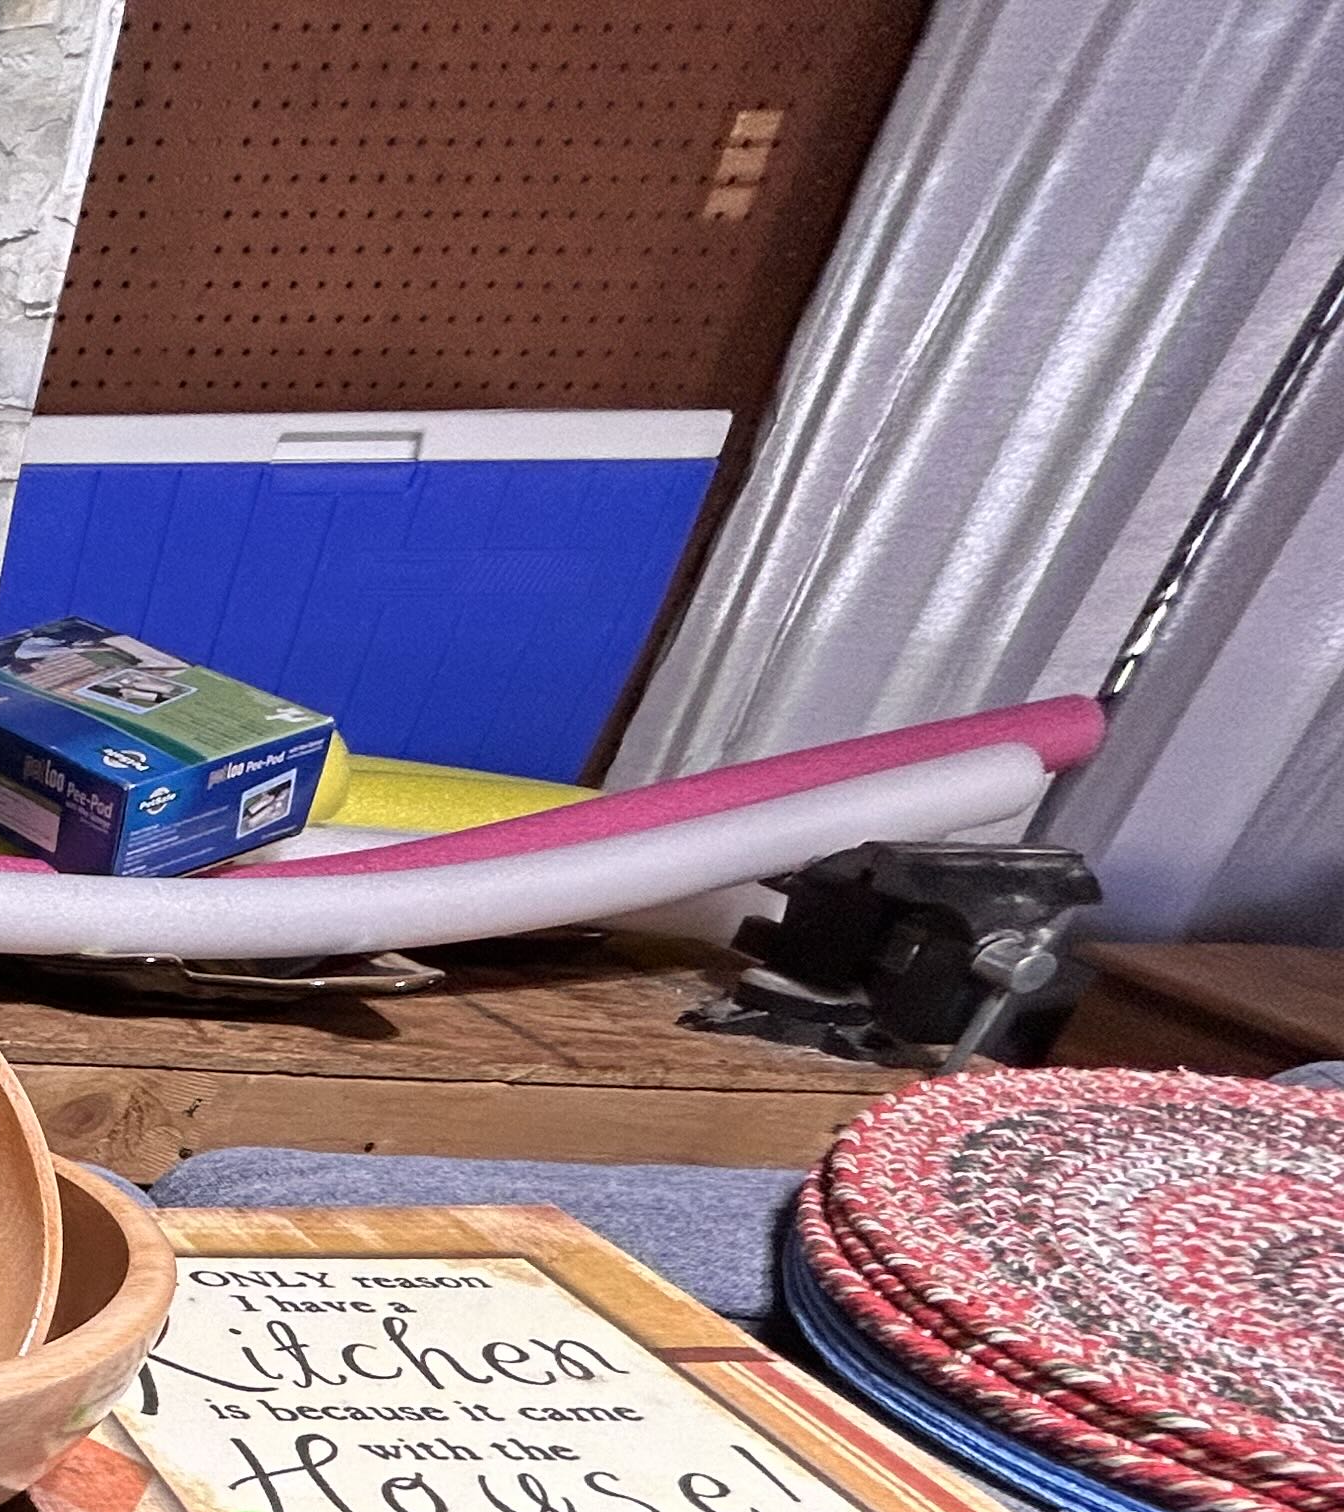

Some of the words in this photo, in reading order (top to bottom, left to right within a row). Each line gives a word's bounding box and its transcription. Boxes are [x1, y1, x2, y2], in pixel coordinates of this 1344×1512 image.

[66, 781, 114, 819] Pee-Pod
[189, 1270, 336, 1288] ONLY
[351, 1276, 494, 1289] reason
[230, 1294, 262, 1312] I
[265, 1294, 376, 1313] have
[387, 1301, 418, 1313] a
[204, 1398, 251, 1420] is
[256, 1399, 450, 1421] because
[452, 1400, 506, 1421] it
[517, 1406, 644, 1422] came
[358, 1438, 484, 1460] with
[490, 1438, 581, 1461] the
